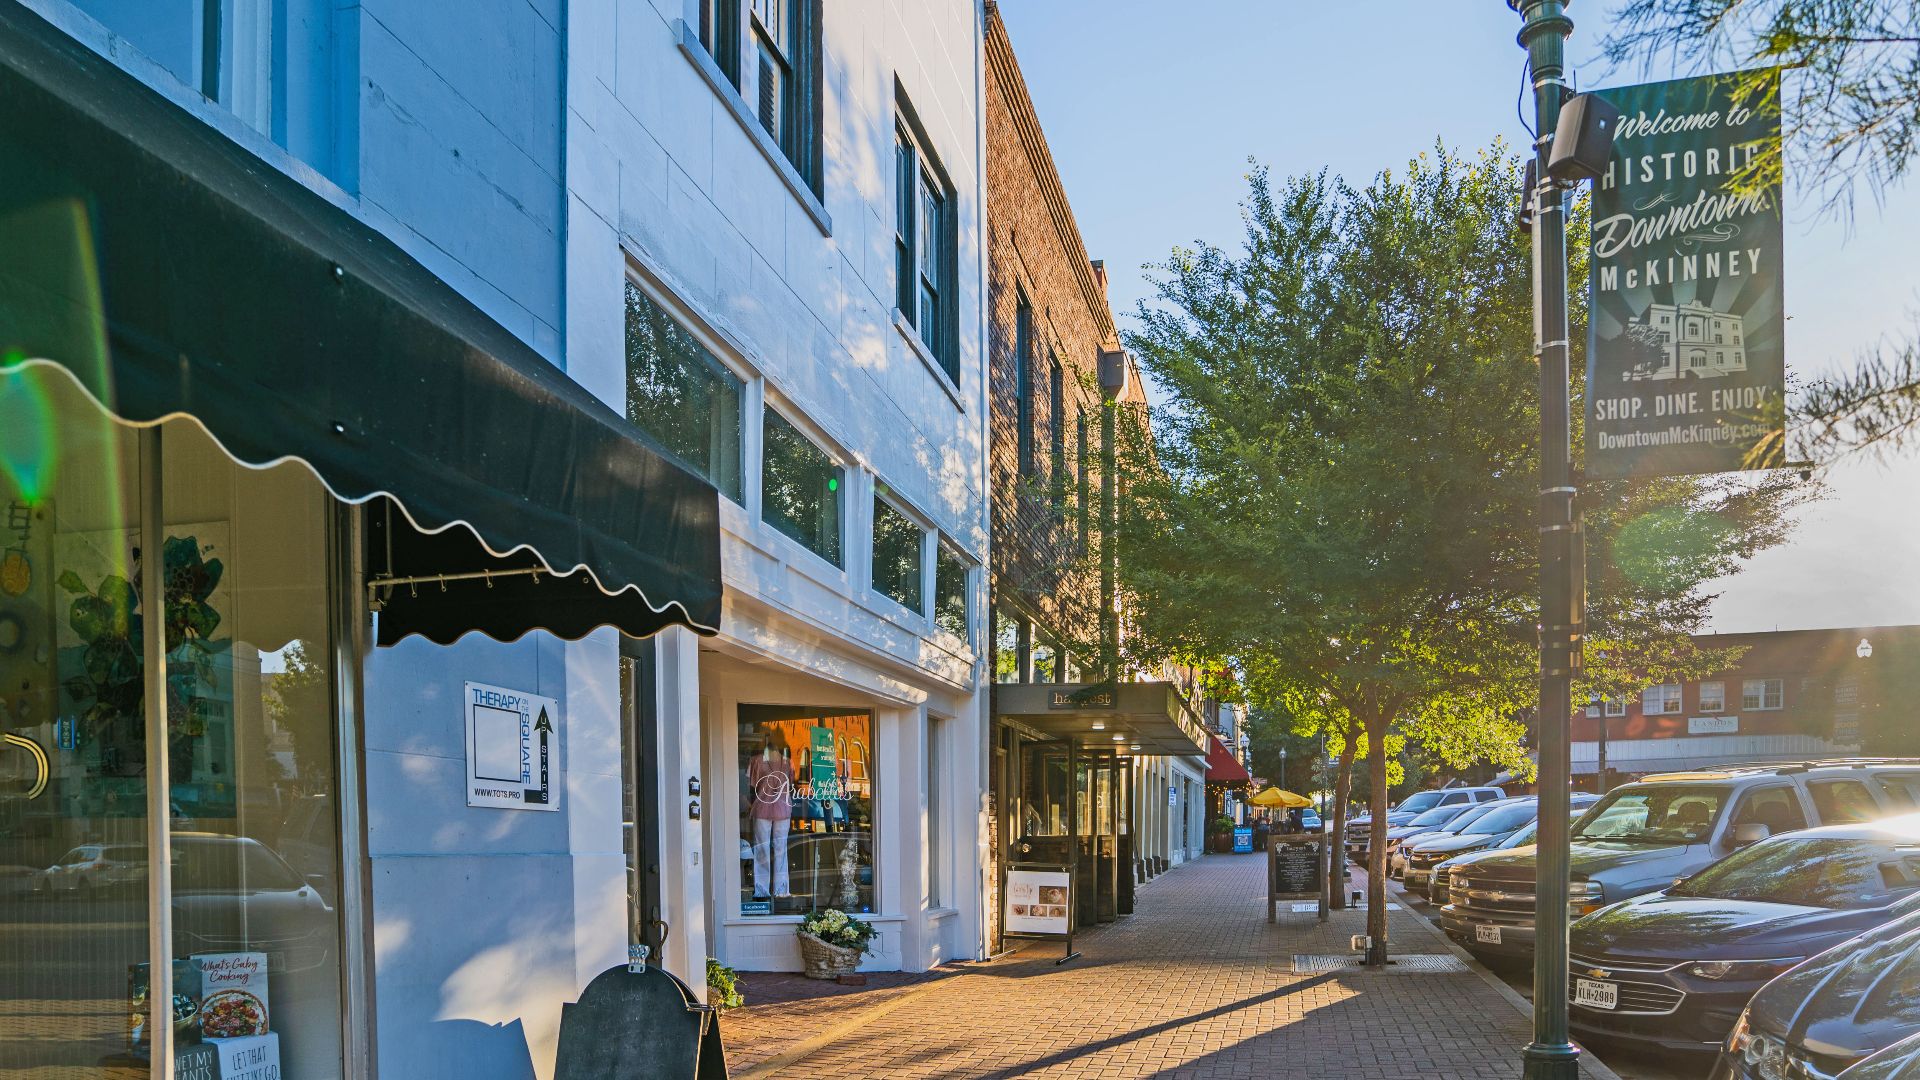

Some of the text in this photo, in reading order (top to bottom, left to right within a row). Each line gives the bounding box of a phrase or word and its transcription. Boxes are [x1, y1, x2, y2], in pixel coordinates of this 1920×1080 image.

[1613, 106, 1750, 142] Welcome to
[1593, 188, 1766, 259] Downtown
[1601, 248, 1761, 291] McKINNEY
[1595, 397, 1648, 421] SHOP.
[1655, 392, 1704, 416] DINE.
[472, 688, 521, 711] THERAPY
[1053, 691, 1111, 704] haest
[521, 712, 531, 784] SQUARE
[231, 956, 258, 973] Gaby
[209, 970, 250, 985] Cooking
[196, 1049, 213, 1067] MY
[232, 1046, 266, 1071] LET THAT
